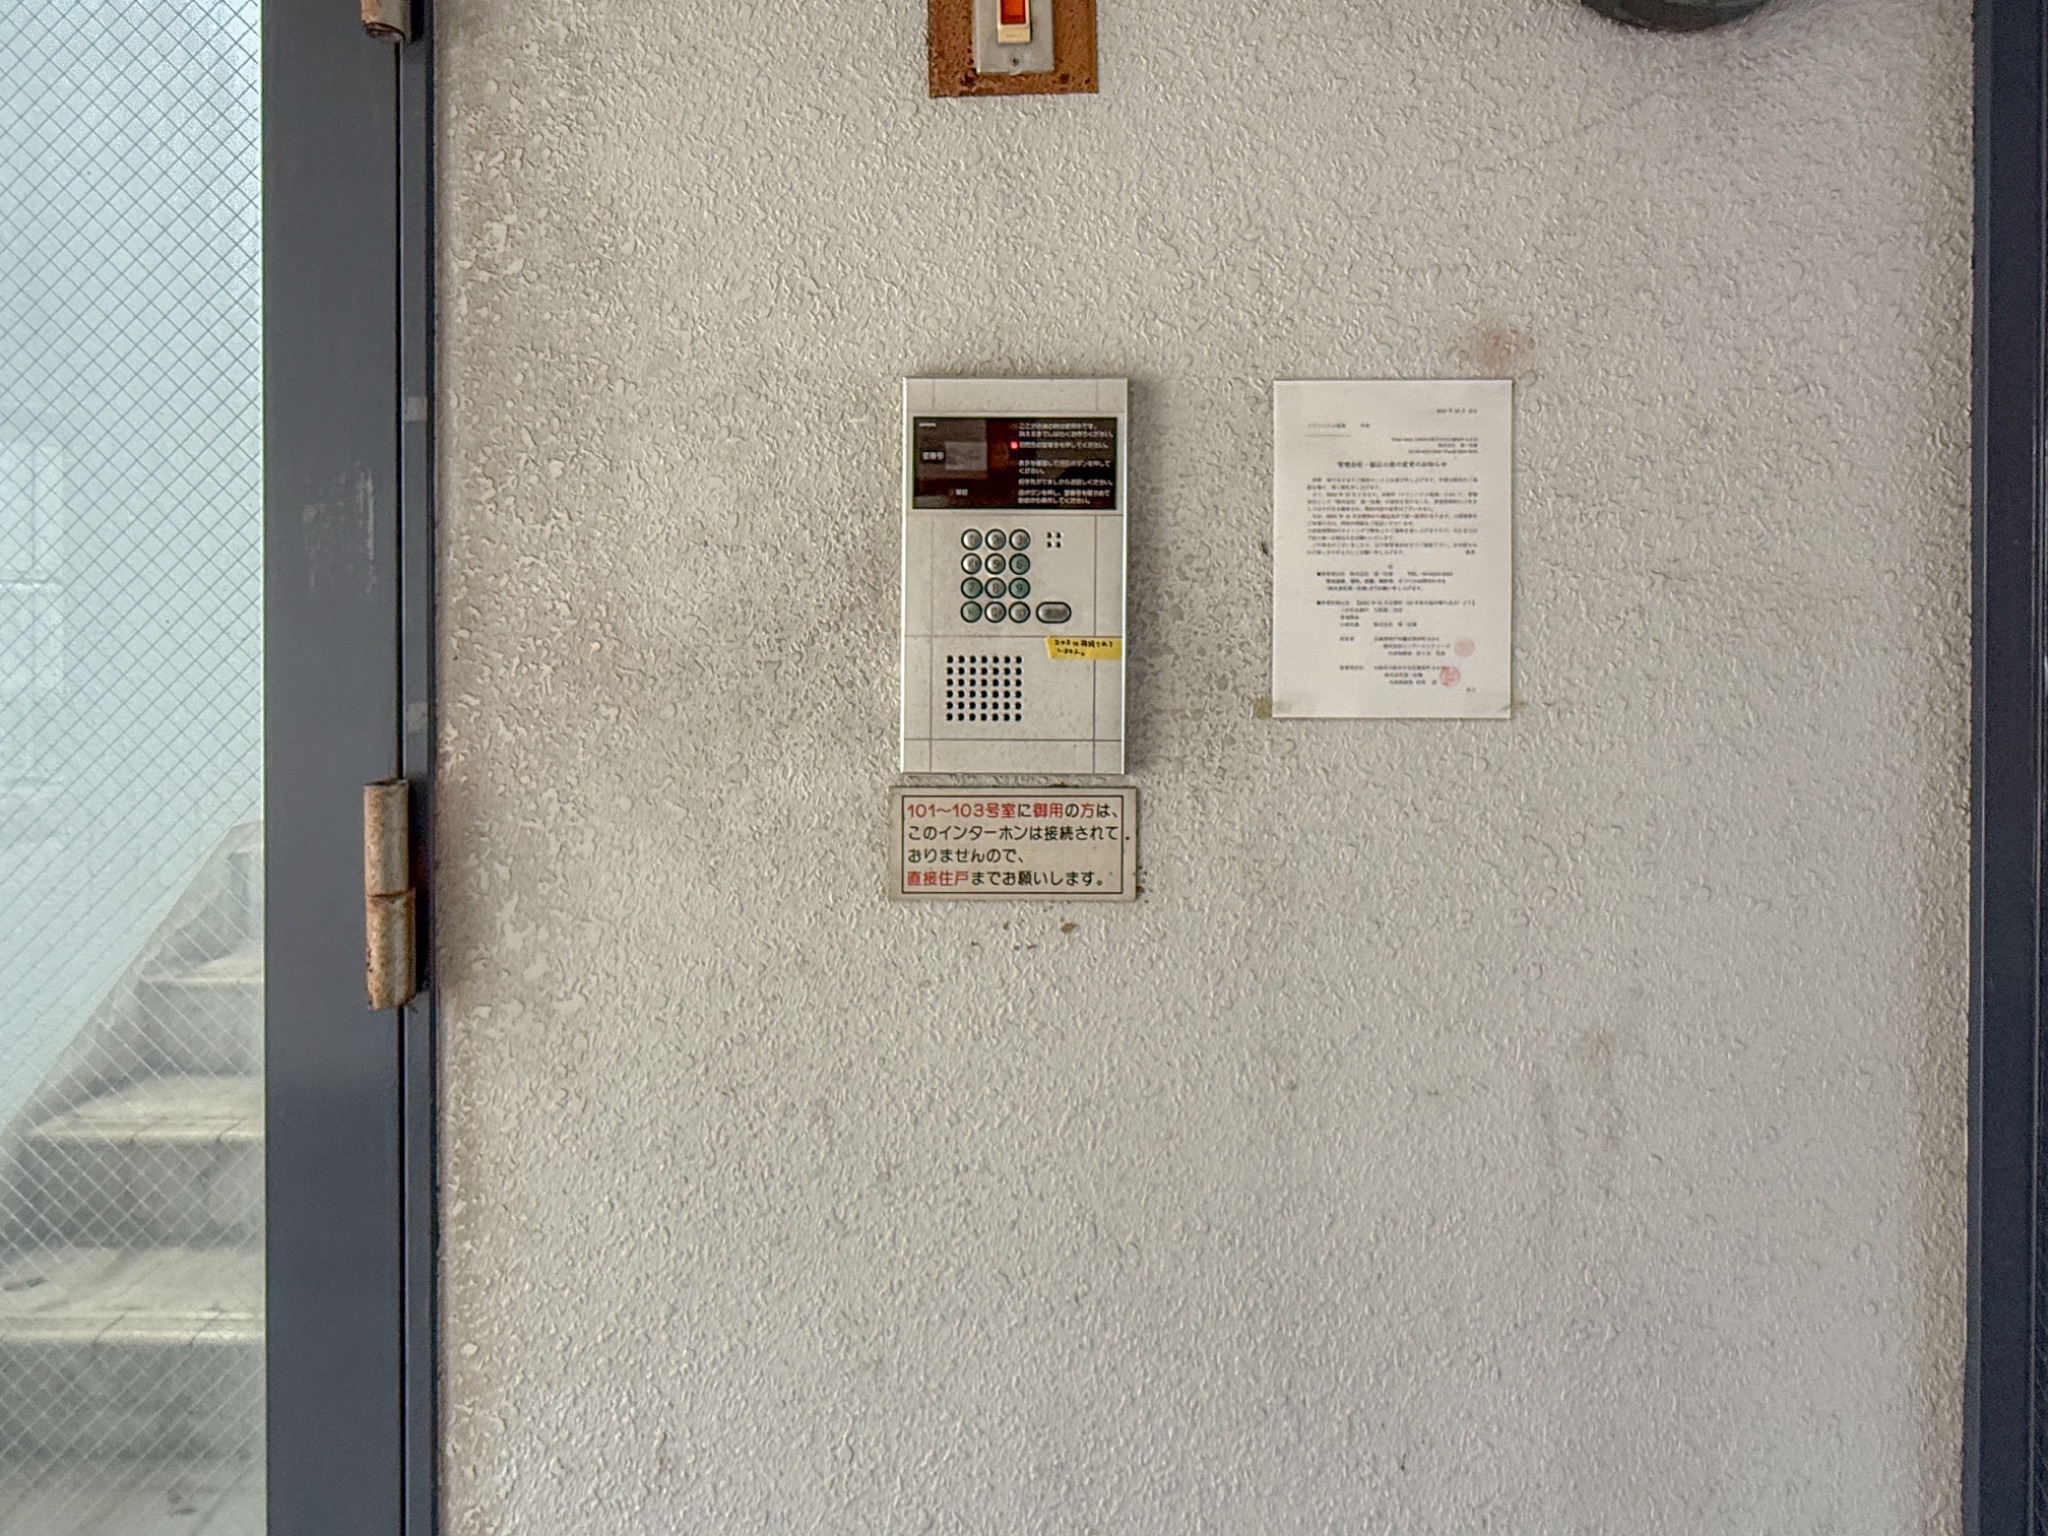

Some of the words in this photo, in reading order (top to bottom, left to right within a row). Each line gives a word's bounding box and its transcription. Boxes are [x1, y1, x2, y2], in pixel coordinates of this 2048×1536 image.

[908, 825, 1119, 841] このインターホンは接続されて
[907, 848, 1025, 864] おりませんので、
[907, 871, 1104, 887] 直接住戸までお願いします。
